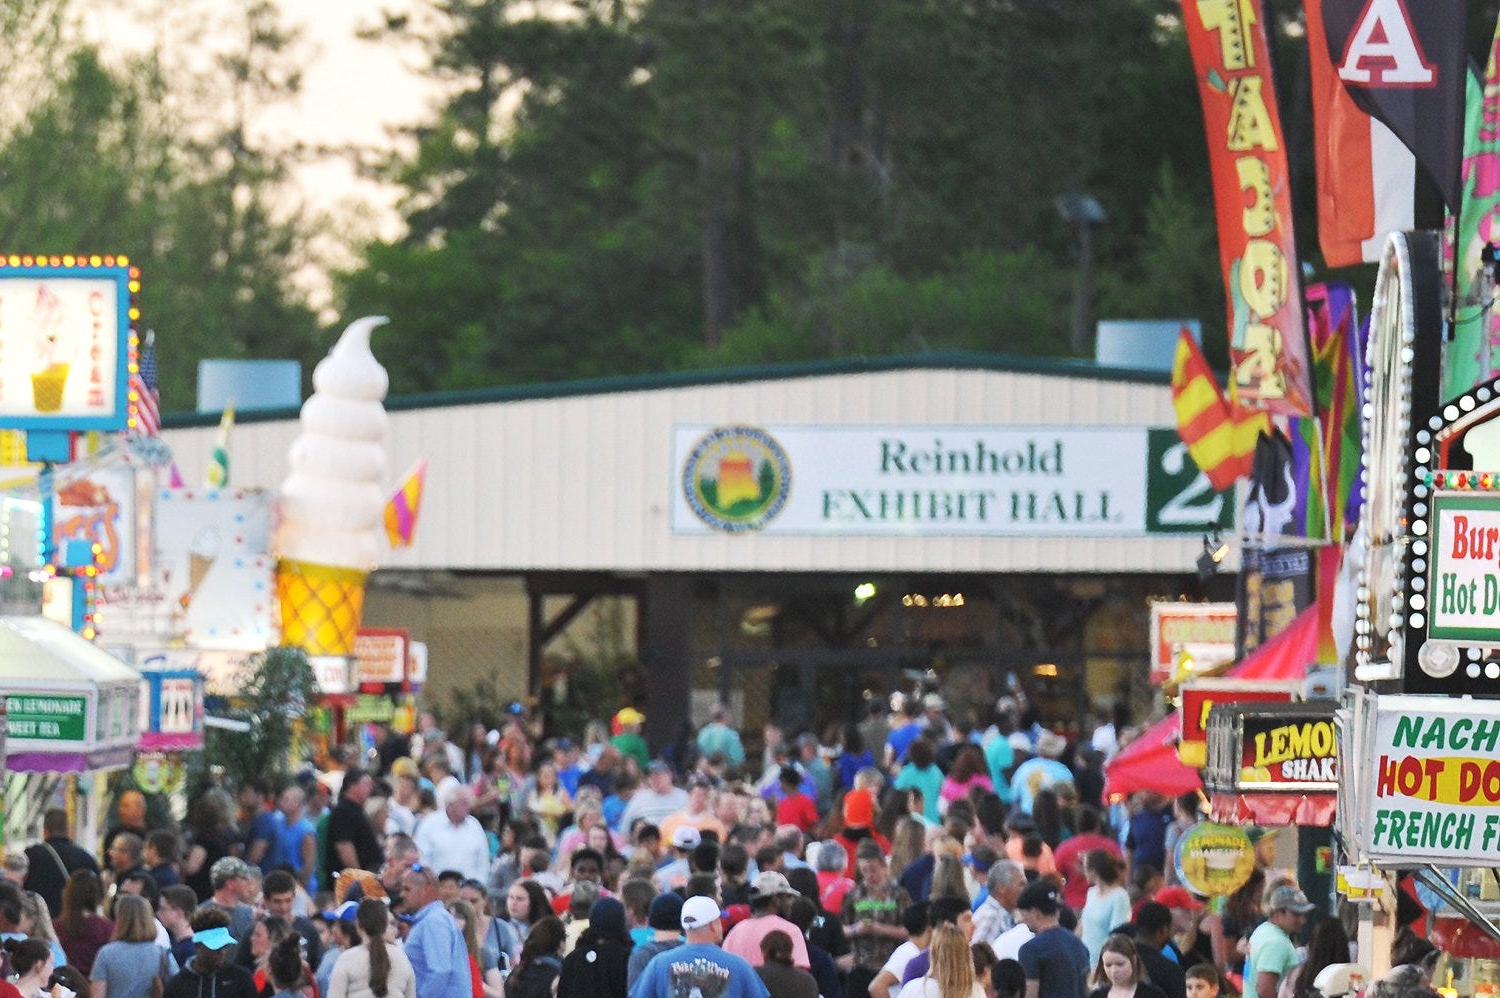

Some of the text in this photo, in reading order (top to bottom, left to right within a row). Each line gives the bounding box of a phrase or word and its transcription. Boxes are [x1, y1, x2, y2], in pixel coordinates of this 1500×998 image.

[879, 437, 1065, 474] Reinhold
[819, 490, 1126, 523] EXHIBIT HALL
[1451, 513, 1500, 561] Bur
[1441, 572, 1477, 617] Hot
[1392, 715, 1500, 752] NACH
[1281, 758, 1337, 781] SHAK
[1376, 754, 1500, 804] HOT DO
[1372, 809, 1475, 851] FRENCH
